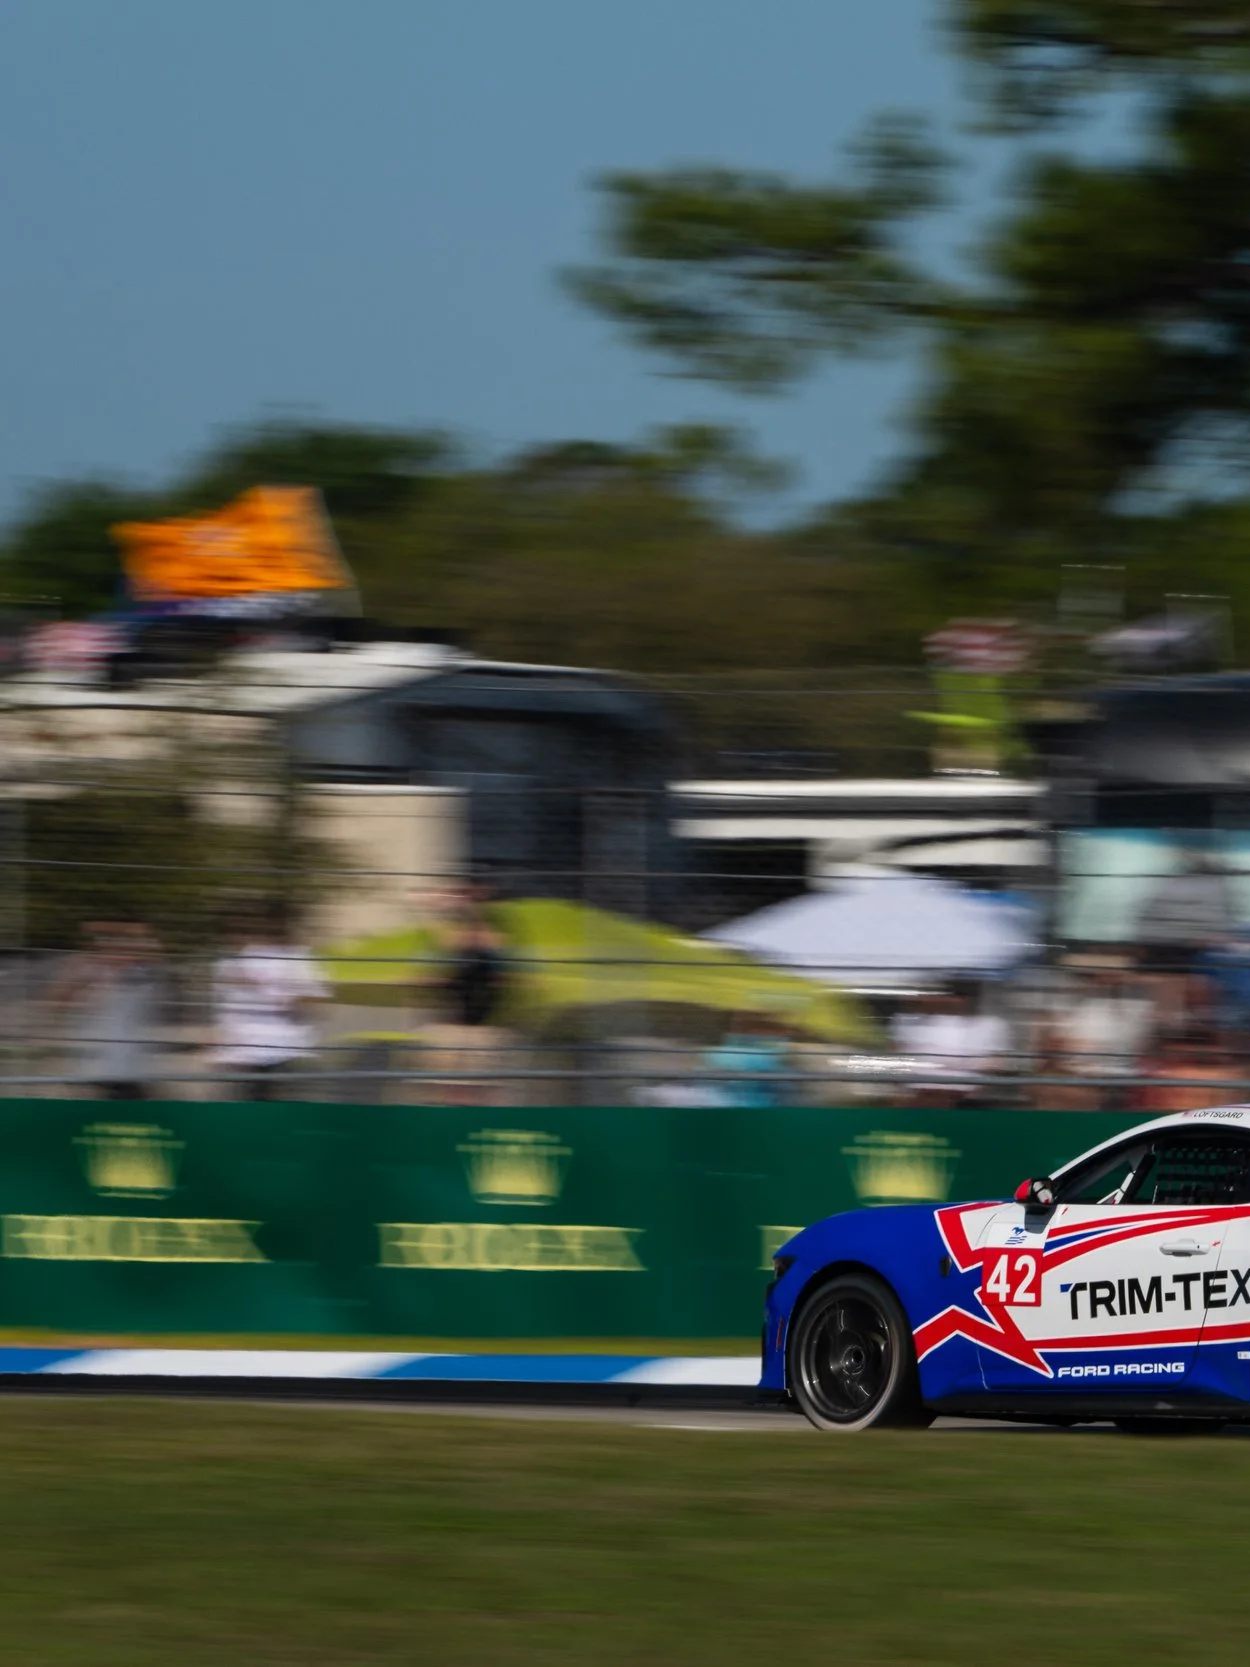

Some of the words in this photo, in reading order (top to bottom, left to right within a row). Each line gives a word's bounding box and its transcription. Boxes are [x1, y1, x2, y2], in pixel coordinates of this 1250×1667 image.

[986, 1254, 1036, 1304] 42
[1058, 1365, 1110, 1378] FORD
[1113, 1361, 1185, 1376] RACING
